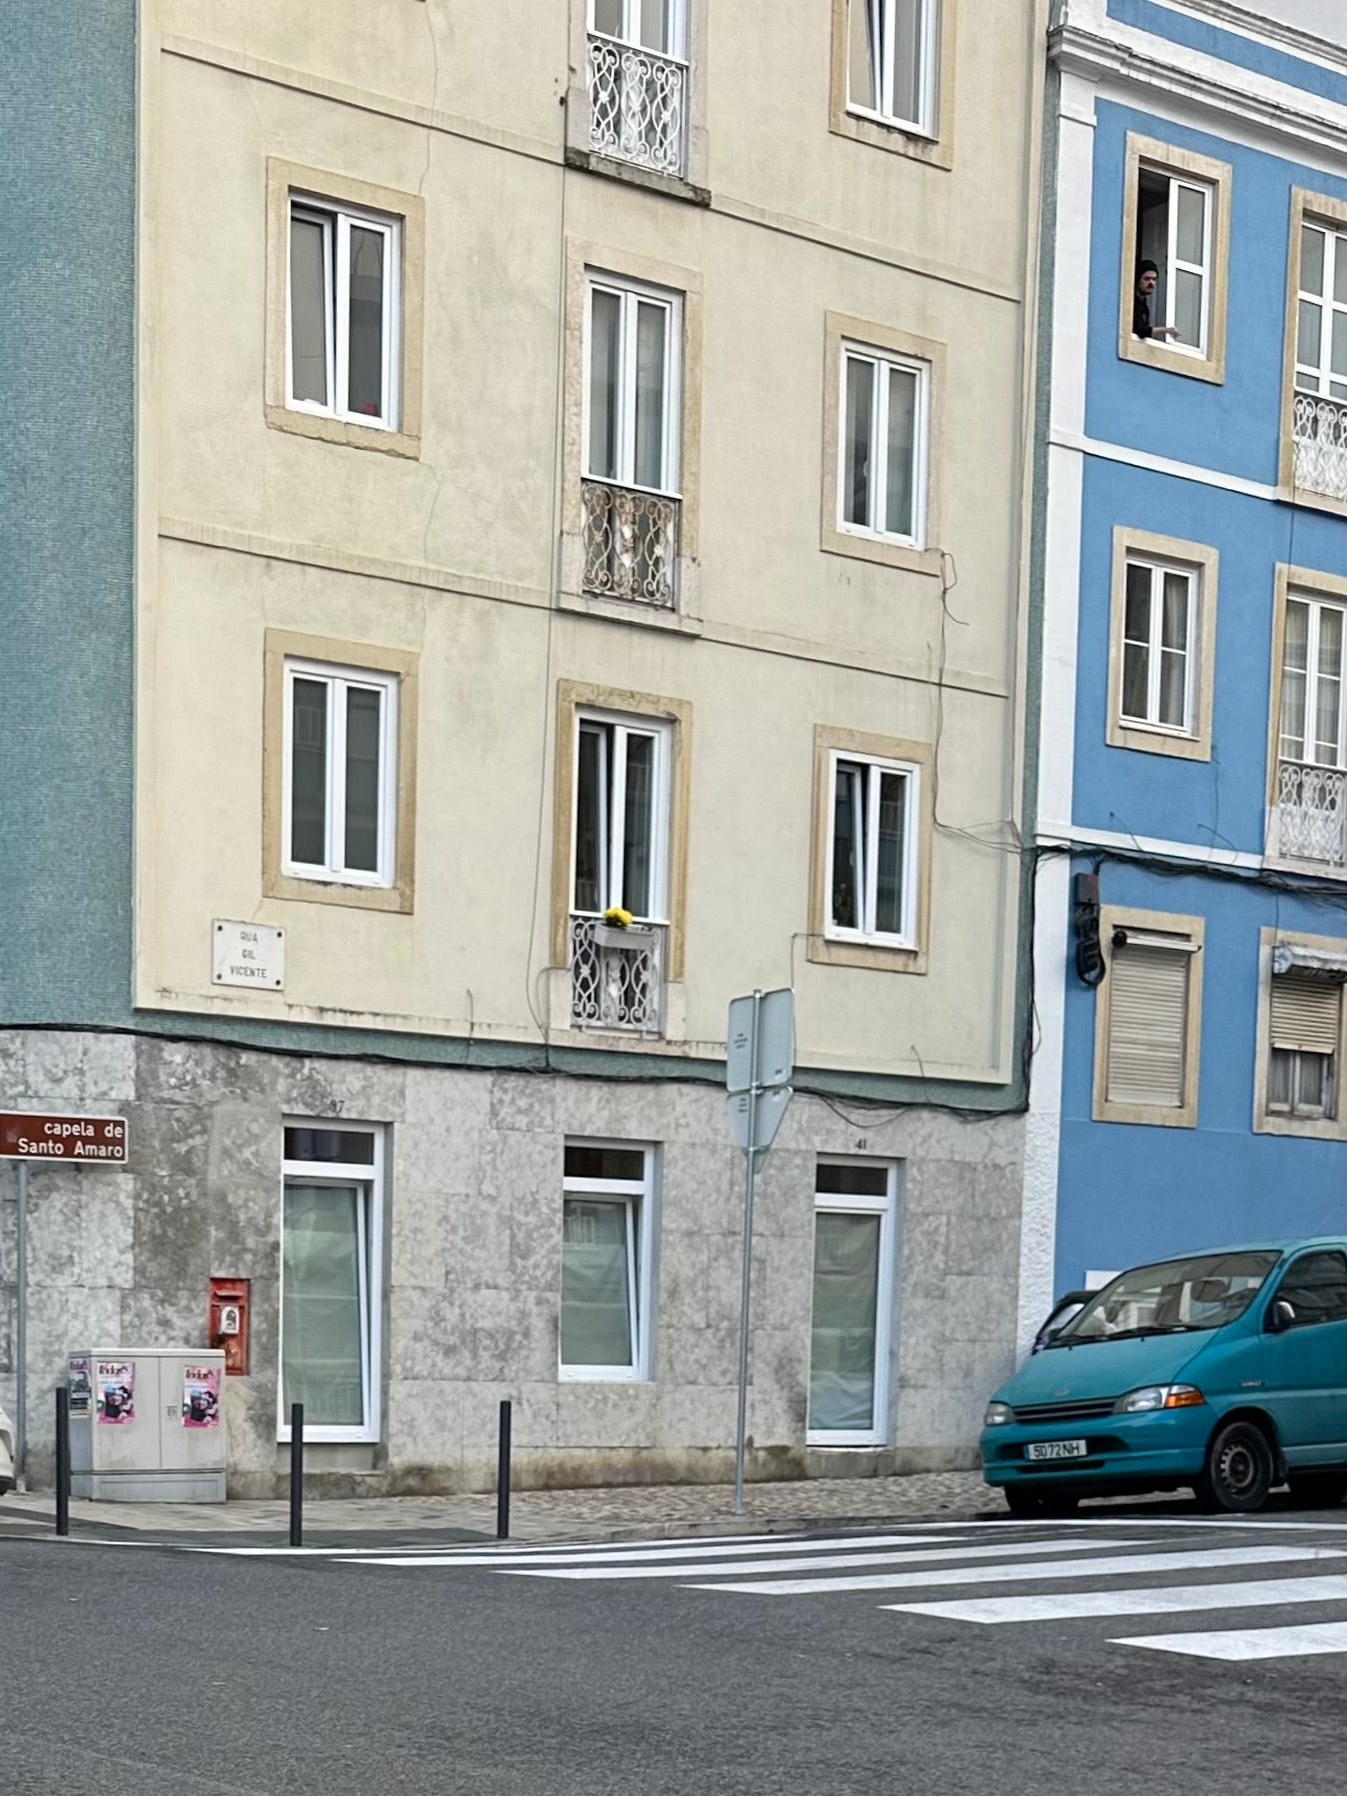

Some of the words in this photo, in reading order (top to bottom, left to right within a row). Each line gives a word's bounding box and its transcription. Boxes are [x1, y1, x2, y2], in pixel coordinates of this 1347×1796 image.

[240, 931, 259, 943] RUA
[242, 949, 257, 960] GIL
[229, 965, 268, 979] VICENTE
[43, 1121, 95, 1138] capela
[104, 1123, 123, 1137] de
[18, 1138, 64, 1155] Santo
[73, 1141, 123, 1157] Amaro
